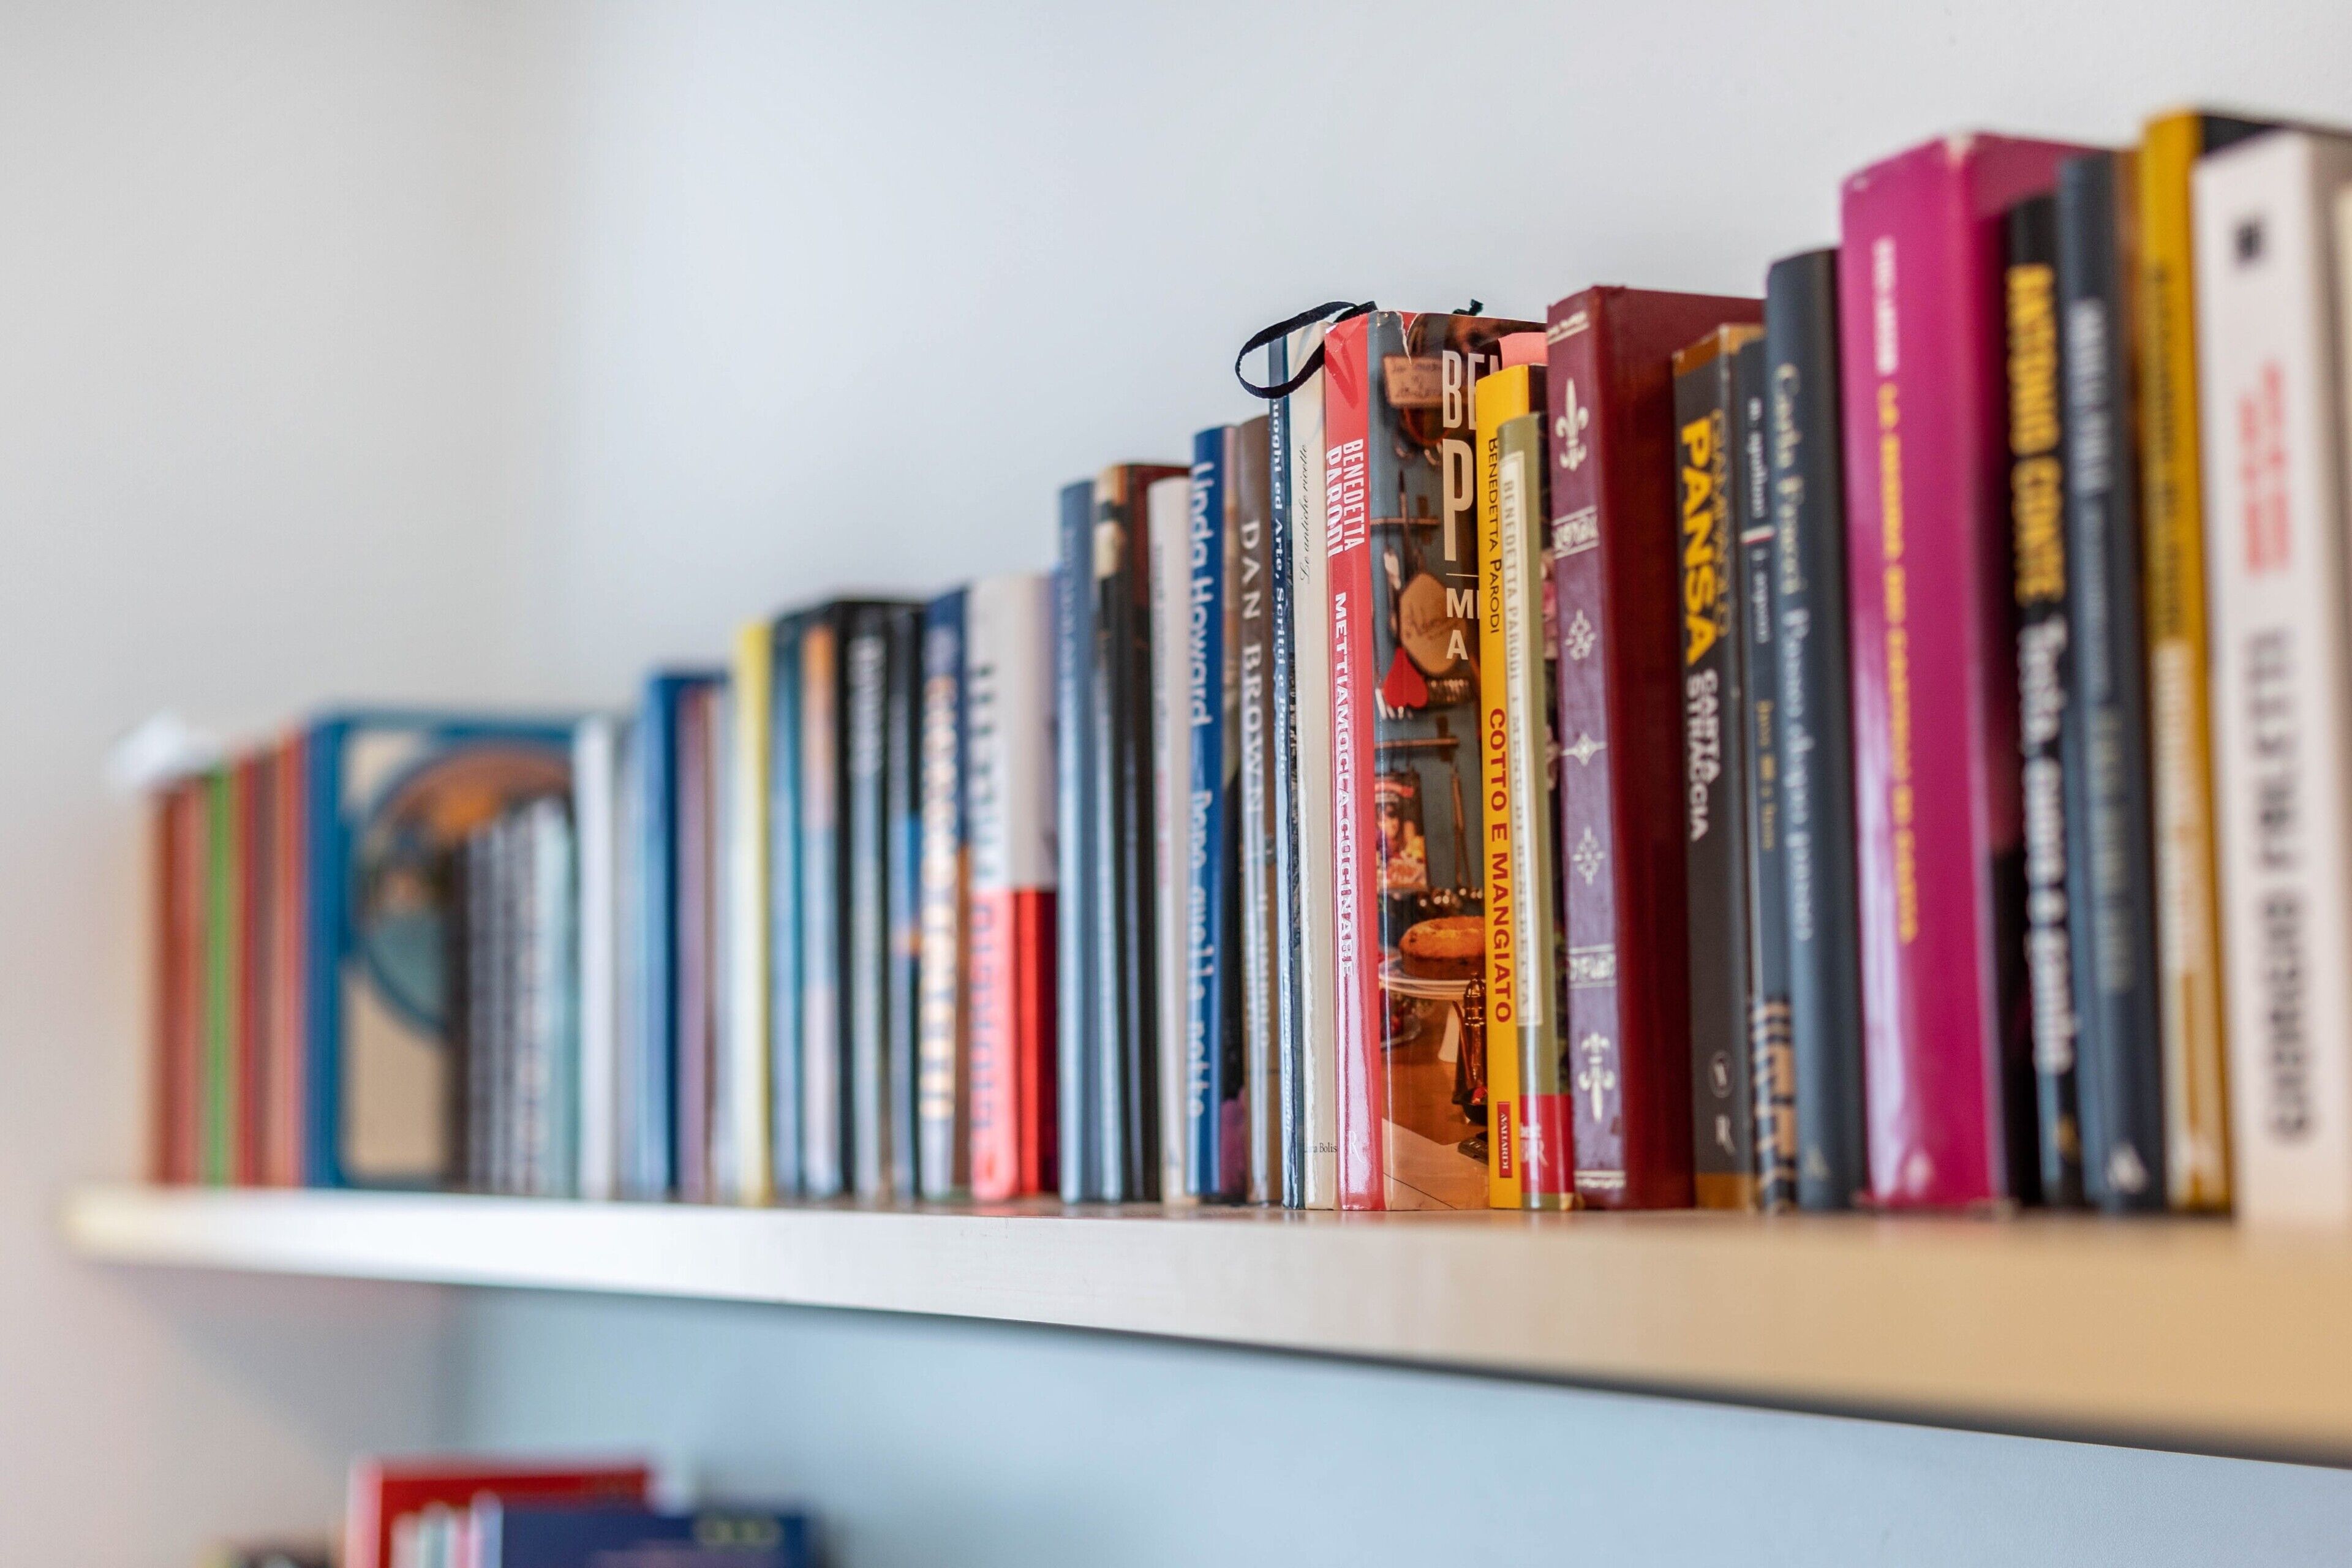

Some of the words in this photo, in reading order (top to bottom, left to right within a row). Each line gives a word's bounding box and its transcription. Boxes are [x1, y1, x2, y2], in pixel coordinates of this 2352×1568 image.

[2005, 265, 2062, 454] ANTONIO
[1273, 399, 1282, 472] uoghi
[1298, 445, 1309, 492] ricette
[1190, 462, 1216, 570] Linda
[1275, 481, 1283, 509] ed
[1298, 494, 1310, 552] antiche
[1326, 445, 1343, 558] PARODI
[1343, 439, 1365, 551] BENEDETTA
[1489, 438, 1499, 551] BENEDETTA
[1504, 481, 1518, 598] BENEDETTA
[1681, 415, 1717, 668] PANSA
[2010, 457, 2067, 603] CONTE
[1242, 519, 1262, 619] DAN
[1275, 518, 1284, 580] Arte,
[1299, 556, 1311, 584] Le
[1489, 559, 1502, 633] PARODI
[1190, 577, 1215, 727] Howard
[1277, 587, 1286, 665] Scritti
[1509, 606, 1520, 680] PARODI
[1242, 643, 1264, 814] BROWN
[1278, 674, 1284, 687] e
[1335, 592, 1349, 781] METTIAMOCI
[1703, 668, 1722, 783] CARTA
[1338, 790, 1349, 809] A
[1490, 708, 1507, 812] COTTO
[1686, 673, 1710, 842] STRACCIA
[1491, 823, 1509, 842] E
[1339, 818, 1354, 978] CUCINARE
[1493, 852, 1512, 1023] MANGIATO
[1516, 846, 1529, 1006] BENEDETTA
[1319, 1142, 1338, 1153] Bolis
